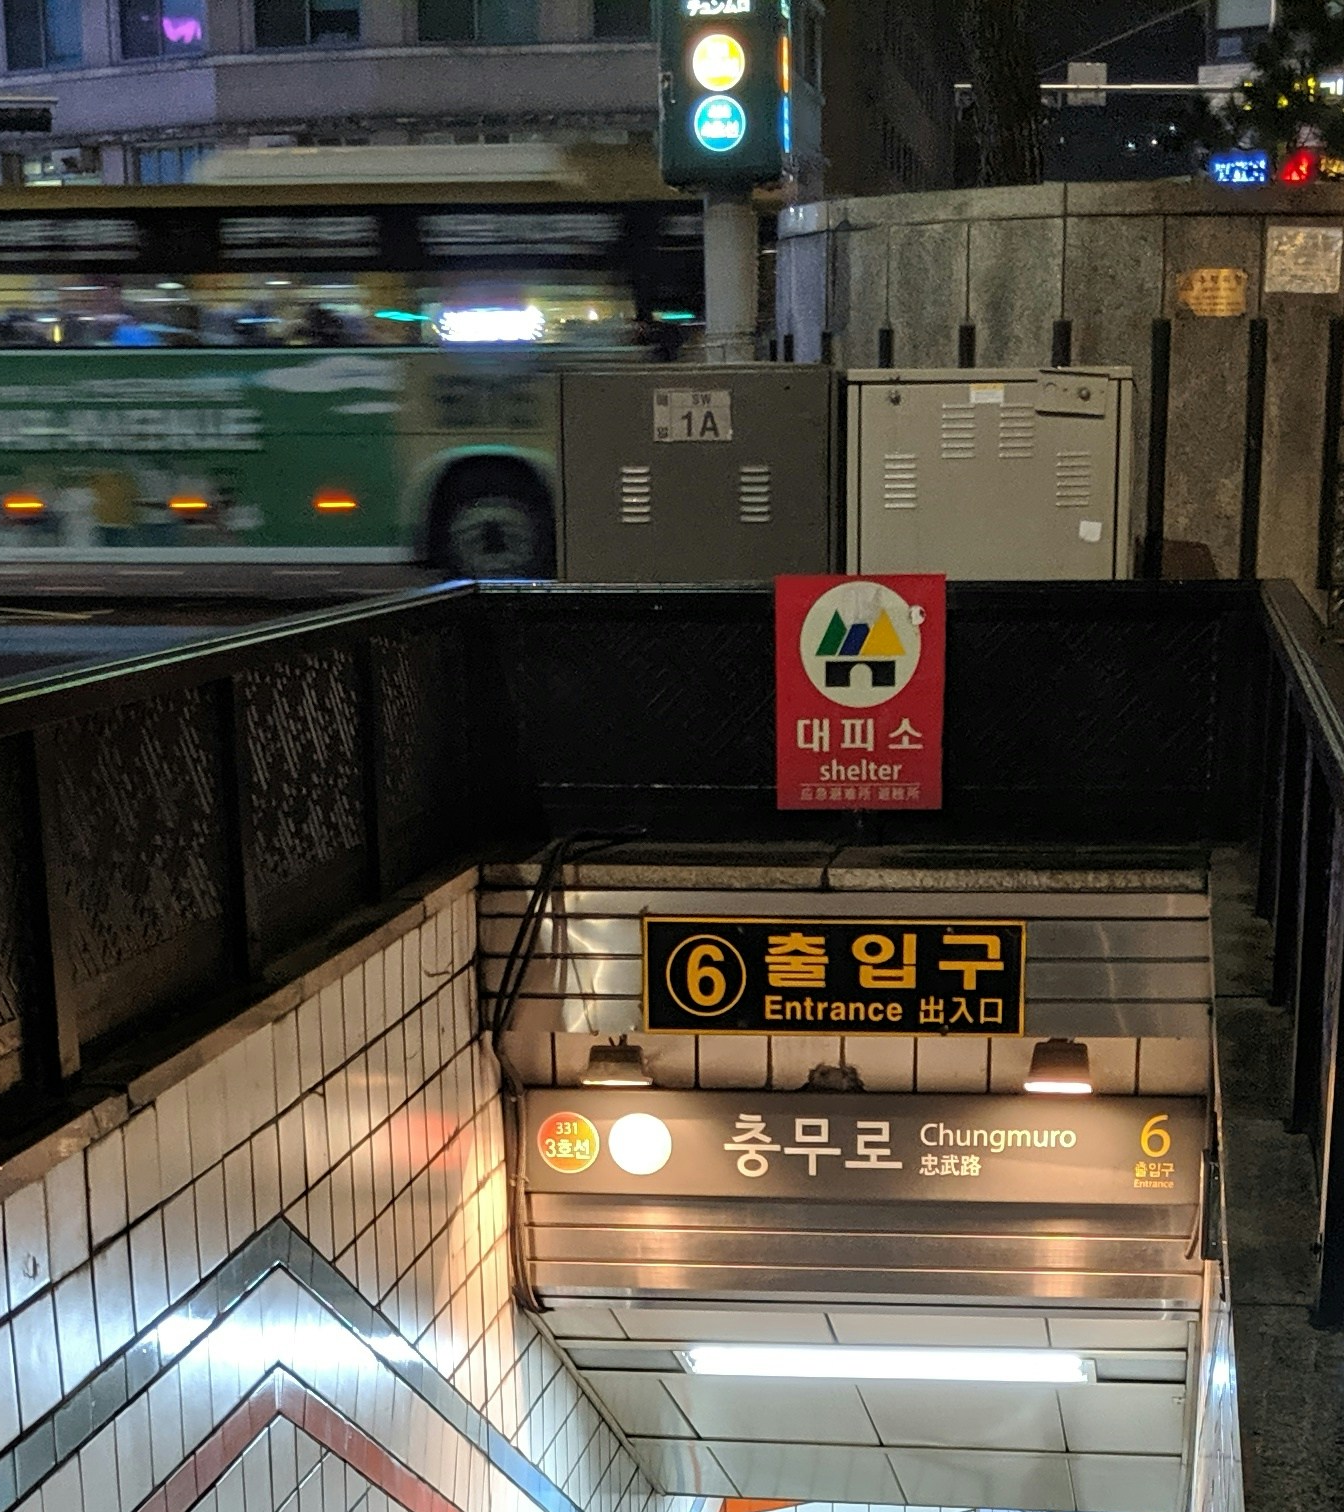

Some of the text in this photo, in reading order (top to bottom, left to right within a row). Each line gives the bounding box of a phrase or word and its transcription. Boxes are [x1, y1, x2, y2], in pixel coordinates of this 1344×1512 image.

[681, 410, 720, 438] 1A
[796, 718, 924, 752] 대피소
[819, 758, 903, 781] shelter
[686, 932, 1005, 1007] 6 출입구
[764, 995, 1004, 1026] Entrance 出入口
[555, 1121, 578, 1135] 331
[1140, 1114, 1171, 1158] 6
[544, 1137, 592, 1160] 3호선
[723, 1113, 1078, 1178] 충무로 Chungmuro
[919, 1153, 983, 1177] 忠武路
[1134, 1160, 1175, 1178] 출입구
[1133, 1178, 1175, 1189] Entrance
